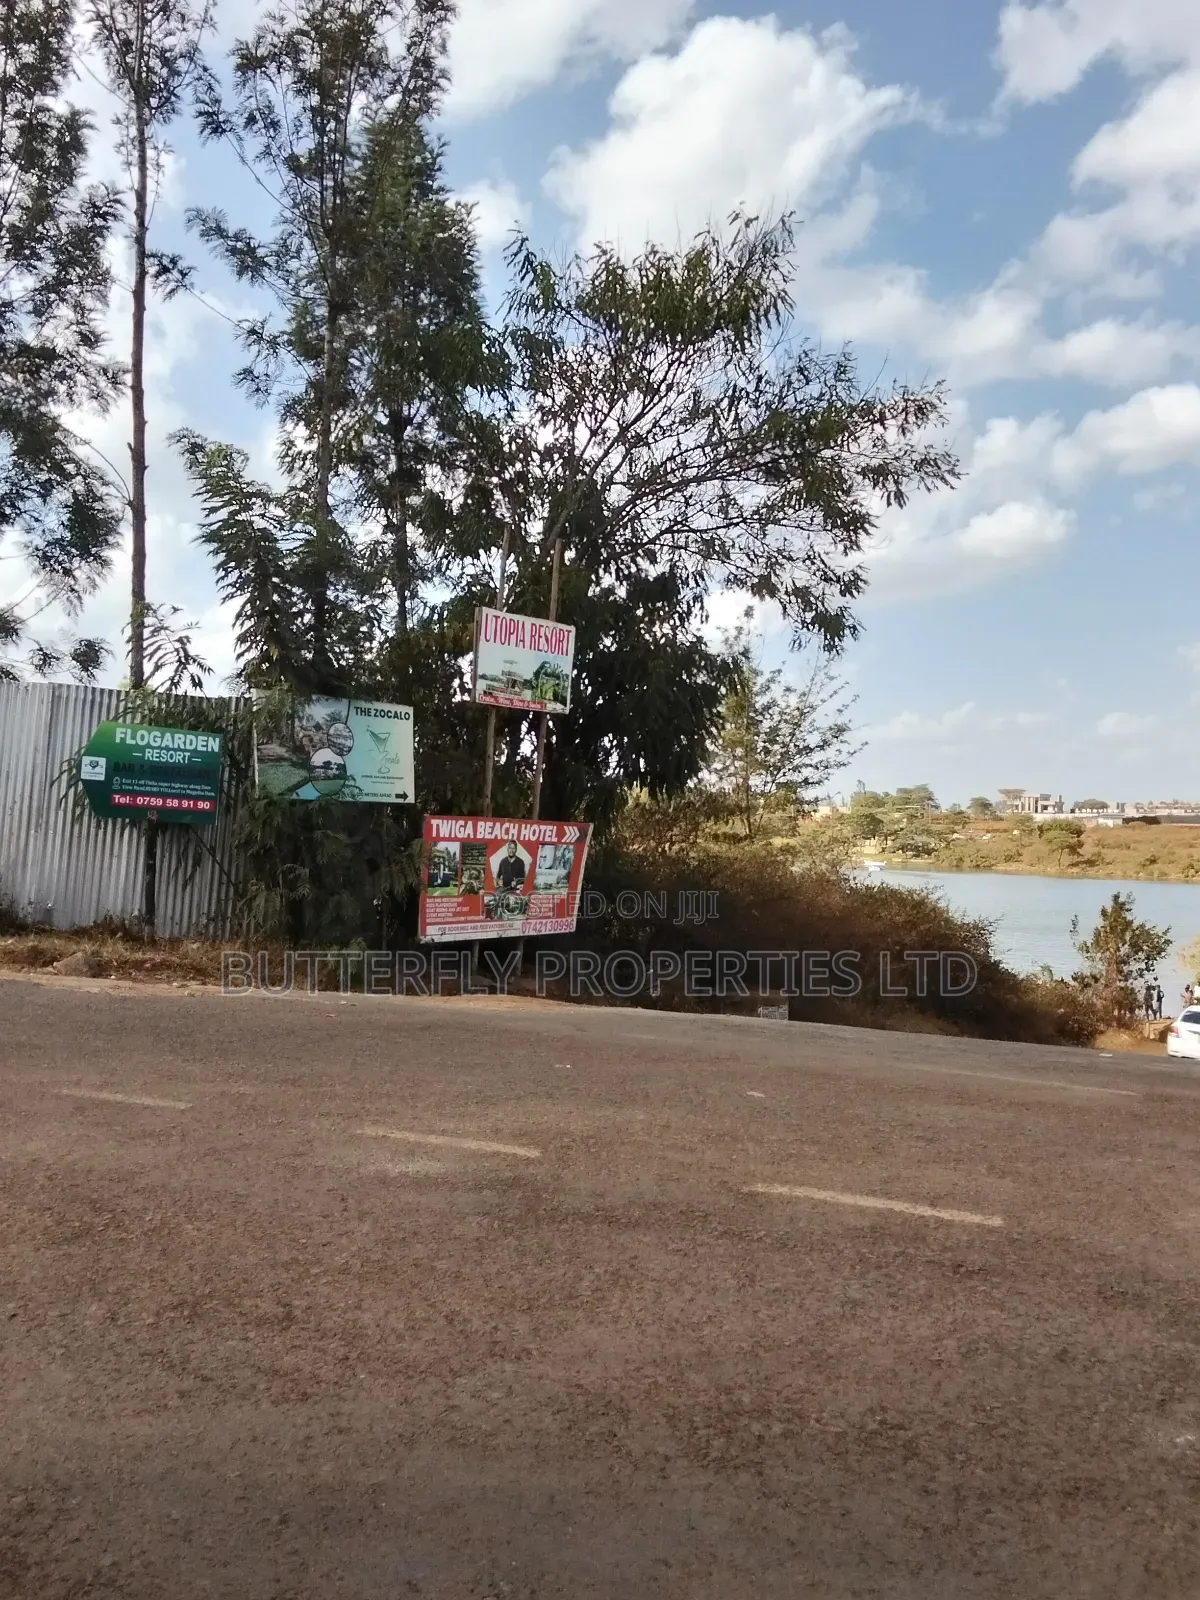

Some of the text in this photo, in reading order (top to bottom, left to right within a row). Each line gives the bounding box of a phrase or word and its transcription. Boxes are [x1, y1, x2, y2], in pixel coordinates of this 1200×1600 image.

[484, 613, 572, 656] UTOPIA RESORT
[354, 706, 411, 721] THE ZOCALO
[115, 727, 220, 752] FLOGARDEN
[145, 748, 190, 764] RESORT
[113, 795, 210, 810] Tel: 0759 58 91 90
[430, 819, 558, 842] TWIGA BEACH HOTEL
[521, 919, 575, 934] 0742130996
